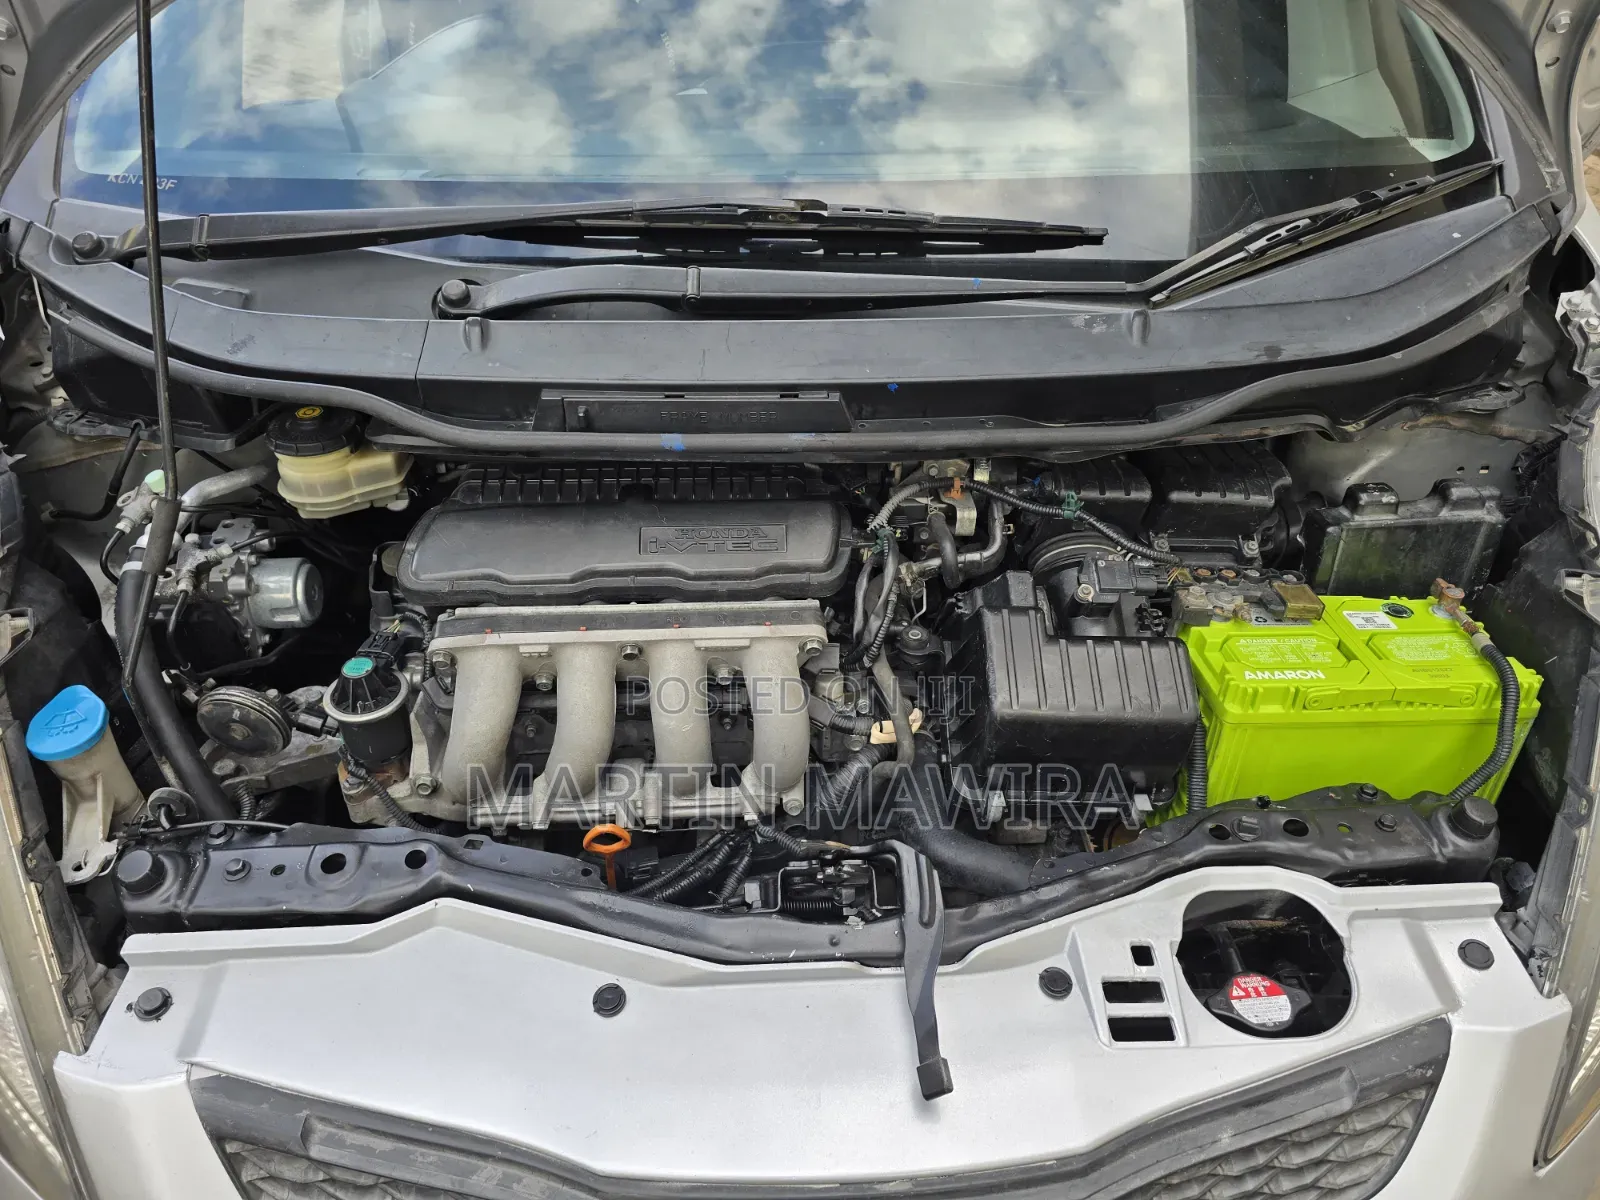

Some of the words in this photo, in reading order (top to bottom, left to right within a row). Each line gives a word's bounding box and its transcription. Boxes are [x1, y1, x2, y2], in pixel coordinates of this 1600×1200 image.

[107, 172, 138, 185] KCN
[674, 527, 768, 539] HONDA
[648, 537, 778, 554] i-VTEC
[1243, 669, 1326, 681] AMARON
